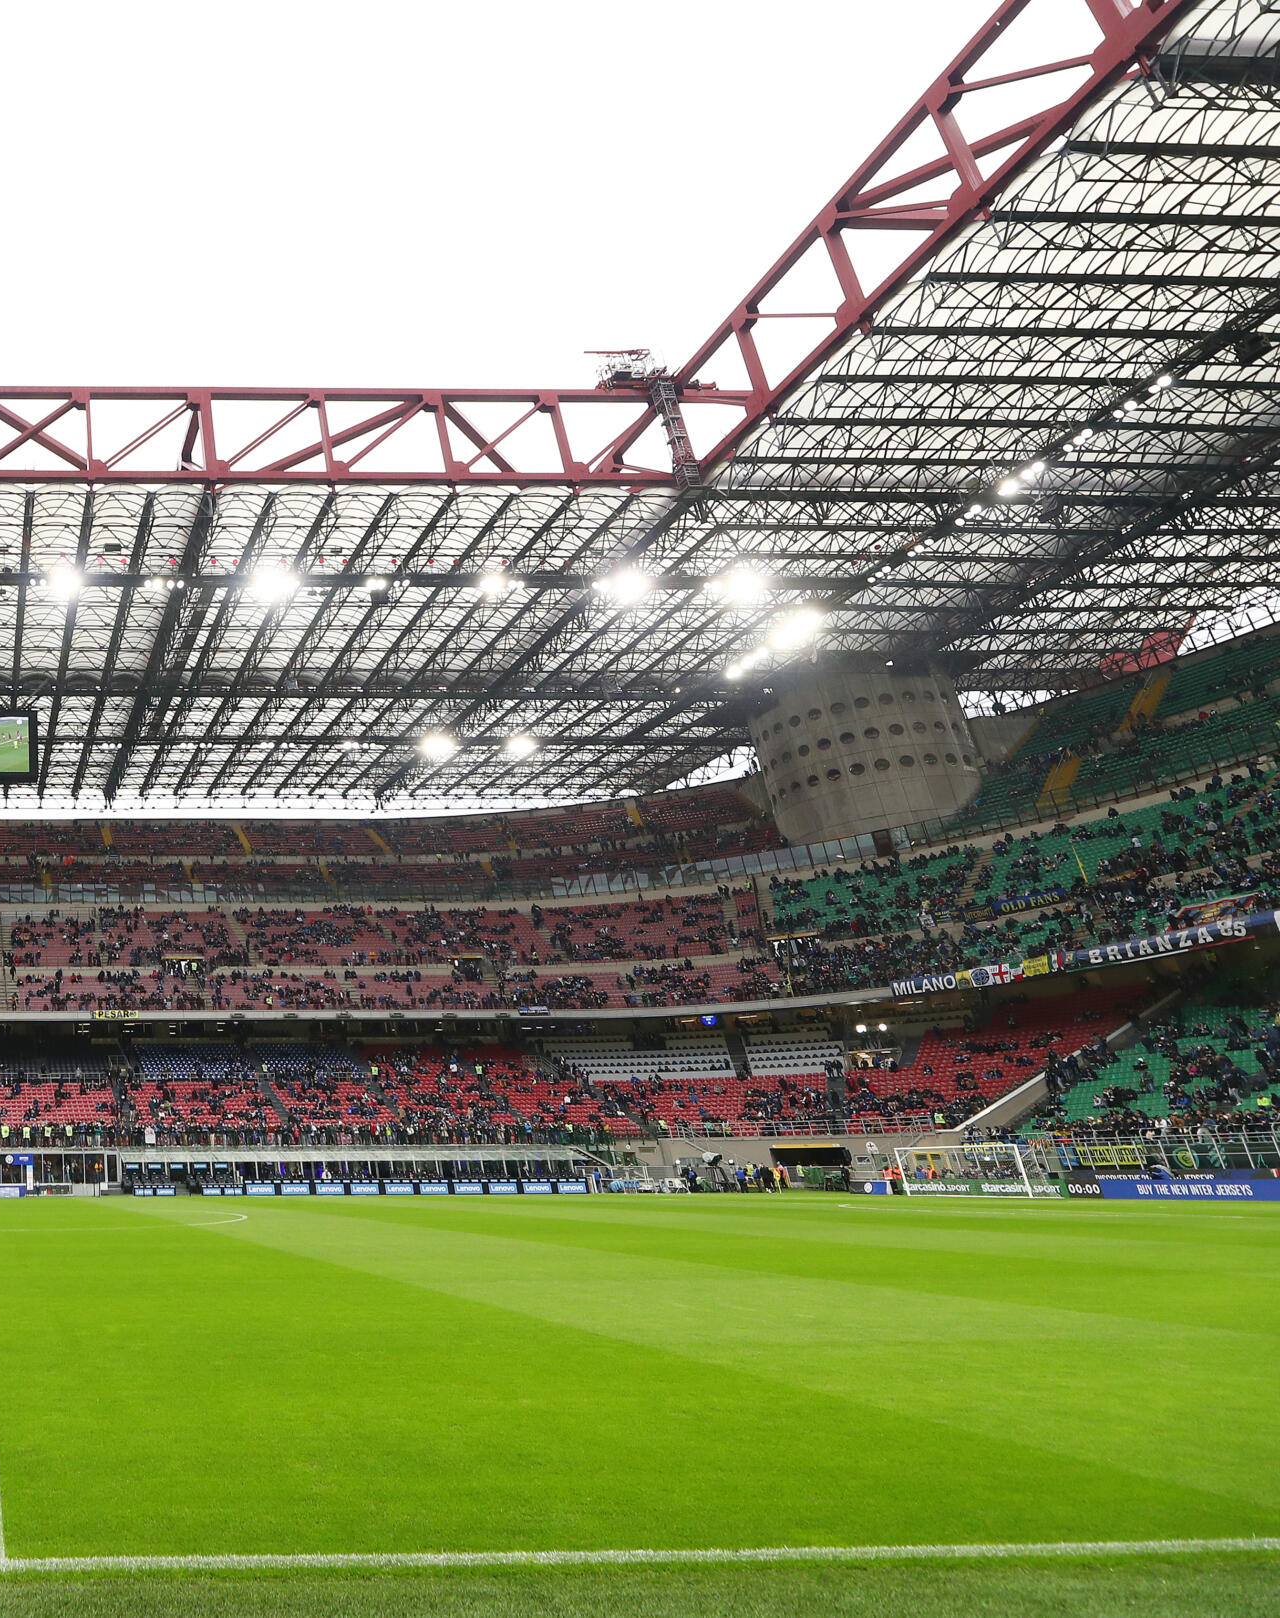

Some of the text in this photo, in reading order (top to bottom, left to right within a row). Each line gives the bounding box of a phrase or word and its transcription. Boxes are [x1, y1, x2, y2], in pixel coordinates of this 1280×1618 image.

[1000, 898, 1026, 913] OLD
[1029, 891, 1060, 906] FANS
[1088, 926, 1214, 964] BRIANZA
[892, 975, 956, 996] MILANO
[1068, 1184, 1100, 1194] 00:00
[1136, 1184, 1254, 1196] BUY THE NEW INTER JERSEYS
